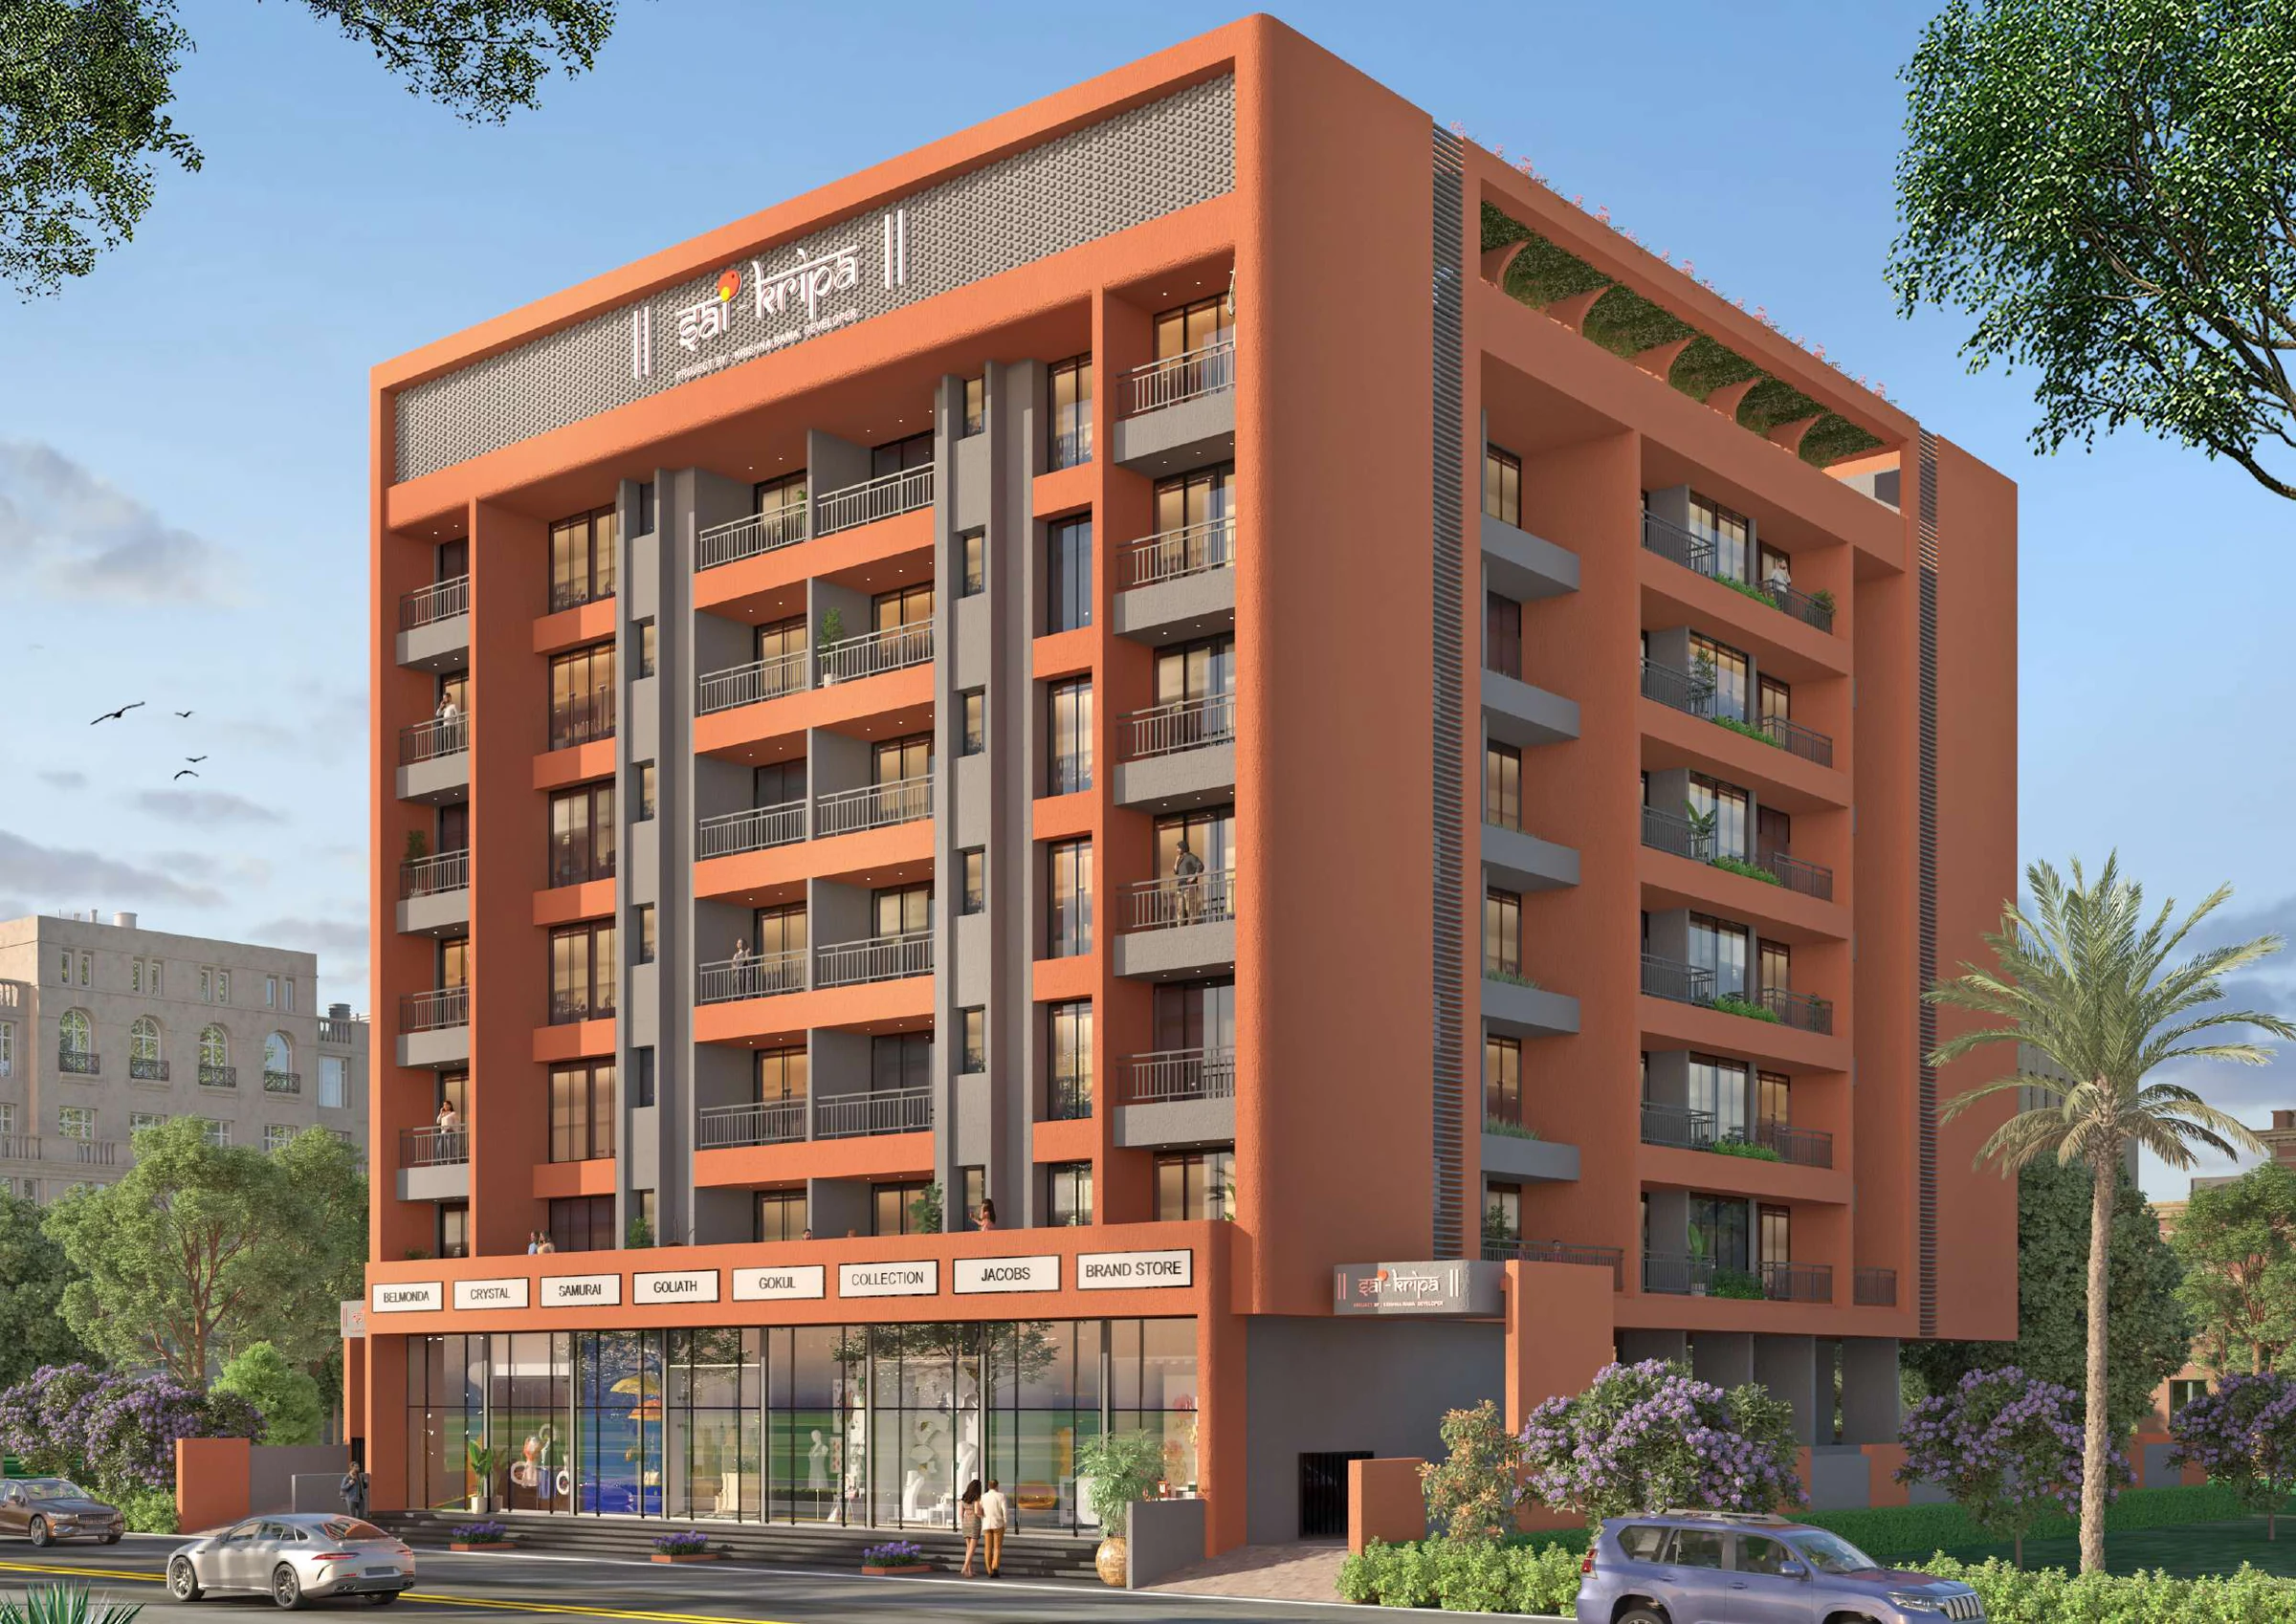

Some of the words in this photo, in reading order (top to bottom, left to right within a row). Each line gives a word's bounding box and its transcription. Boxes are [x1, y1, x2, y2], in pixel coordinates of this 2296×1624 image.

[675, 360, 714, 381] PROJECT
[716, 355, 727, 367] BY
[734, 340, 772, 360] KRISHNA
[805, 308, 858, 335] DEVELOPER
[981, 1267, 1031, 1282] JACOBS
[1086, 1262, 1132, 1278] BRAND
[1136, 1261, 1182, 1276] STORE
[759, 1276, 796, 1289] GOKUL
[851, 1271, 924, 1286] COLLECTION
[470, 1287, 511, 1301] CRYSTAL
[559, 1284, 602, 1297] SAMURAI
[653, 1280, 697, 1294] GOLIATH
[383, 1290, 430, 1304] BELMONDA
